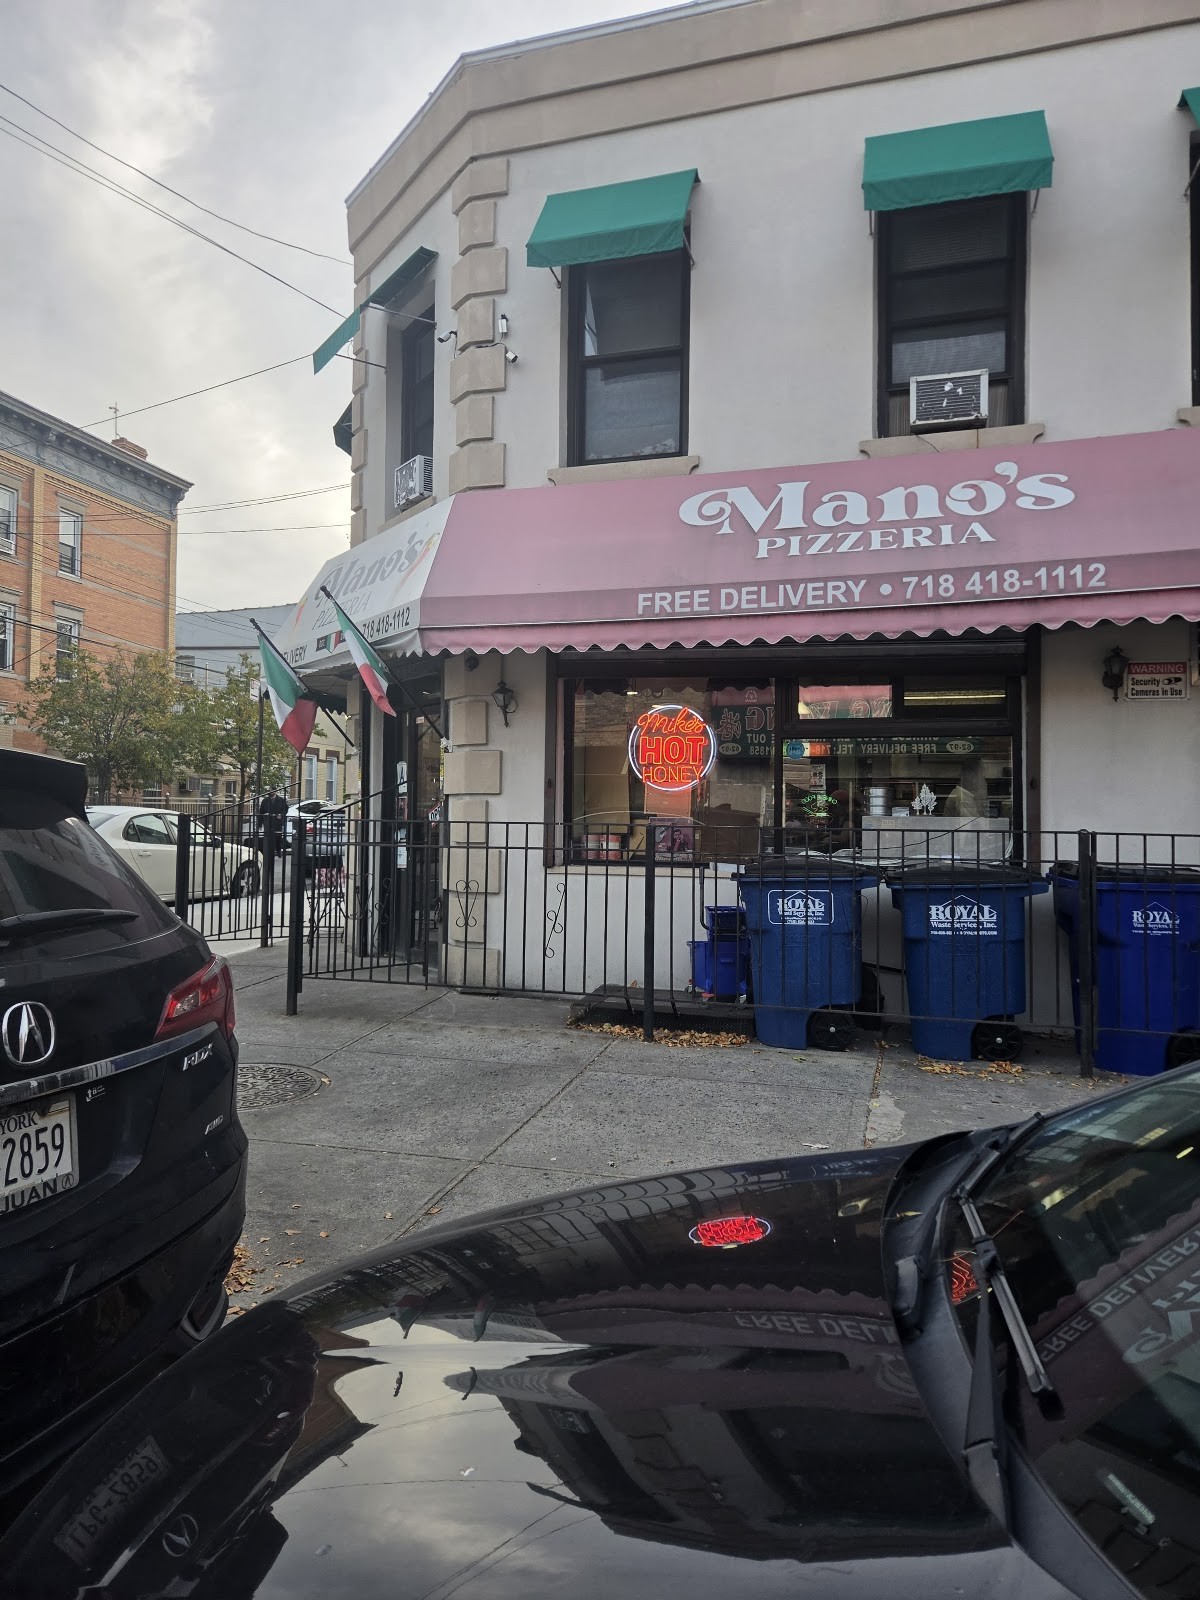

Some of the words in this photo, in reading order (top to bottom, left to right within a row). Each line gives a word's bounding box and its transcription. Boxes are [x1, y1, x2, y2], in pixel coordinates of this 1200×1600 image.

[678, 460, 1076, 535] Mano's
[755, 520, 997, 560] PIZZERIA
[637, 587, 712, 616] FREE
[719, 578, 868, 612] DELIVERY
[902, 572, 956, 600] 718
[964, 562, 1107, 597] 418-1112
[376, 606, 411, 636] 418-1112
[1130, 664, 1184, 674] WARNING
[1130, 677, 1161, 688] Security
[1130, 687, 1160, 697] Cameras
[1170, 687, 1183, 696] Use
[639, 735, 705, 765] HOT
[642, 765, 705, 783] HONEY
[777, 898, 825, 910] ROYAL
[929, 905, 997, 920] ROYAL
[953, 921, 983, 929] Service,
[1132, 910, 1180, 923] ROYA
[182, 1042, 214, 1072] RDX
[0, 1111, 39, 1137] YORK
[2, 1123, 65, 1189] 2859
